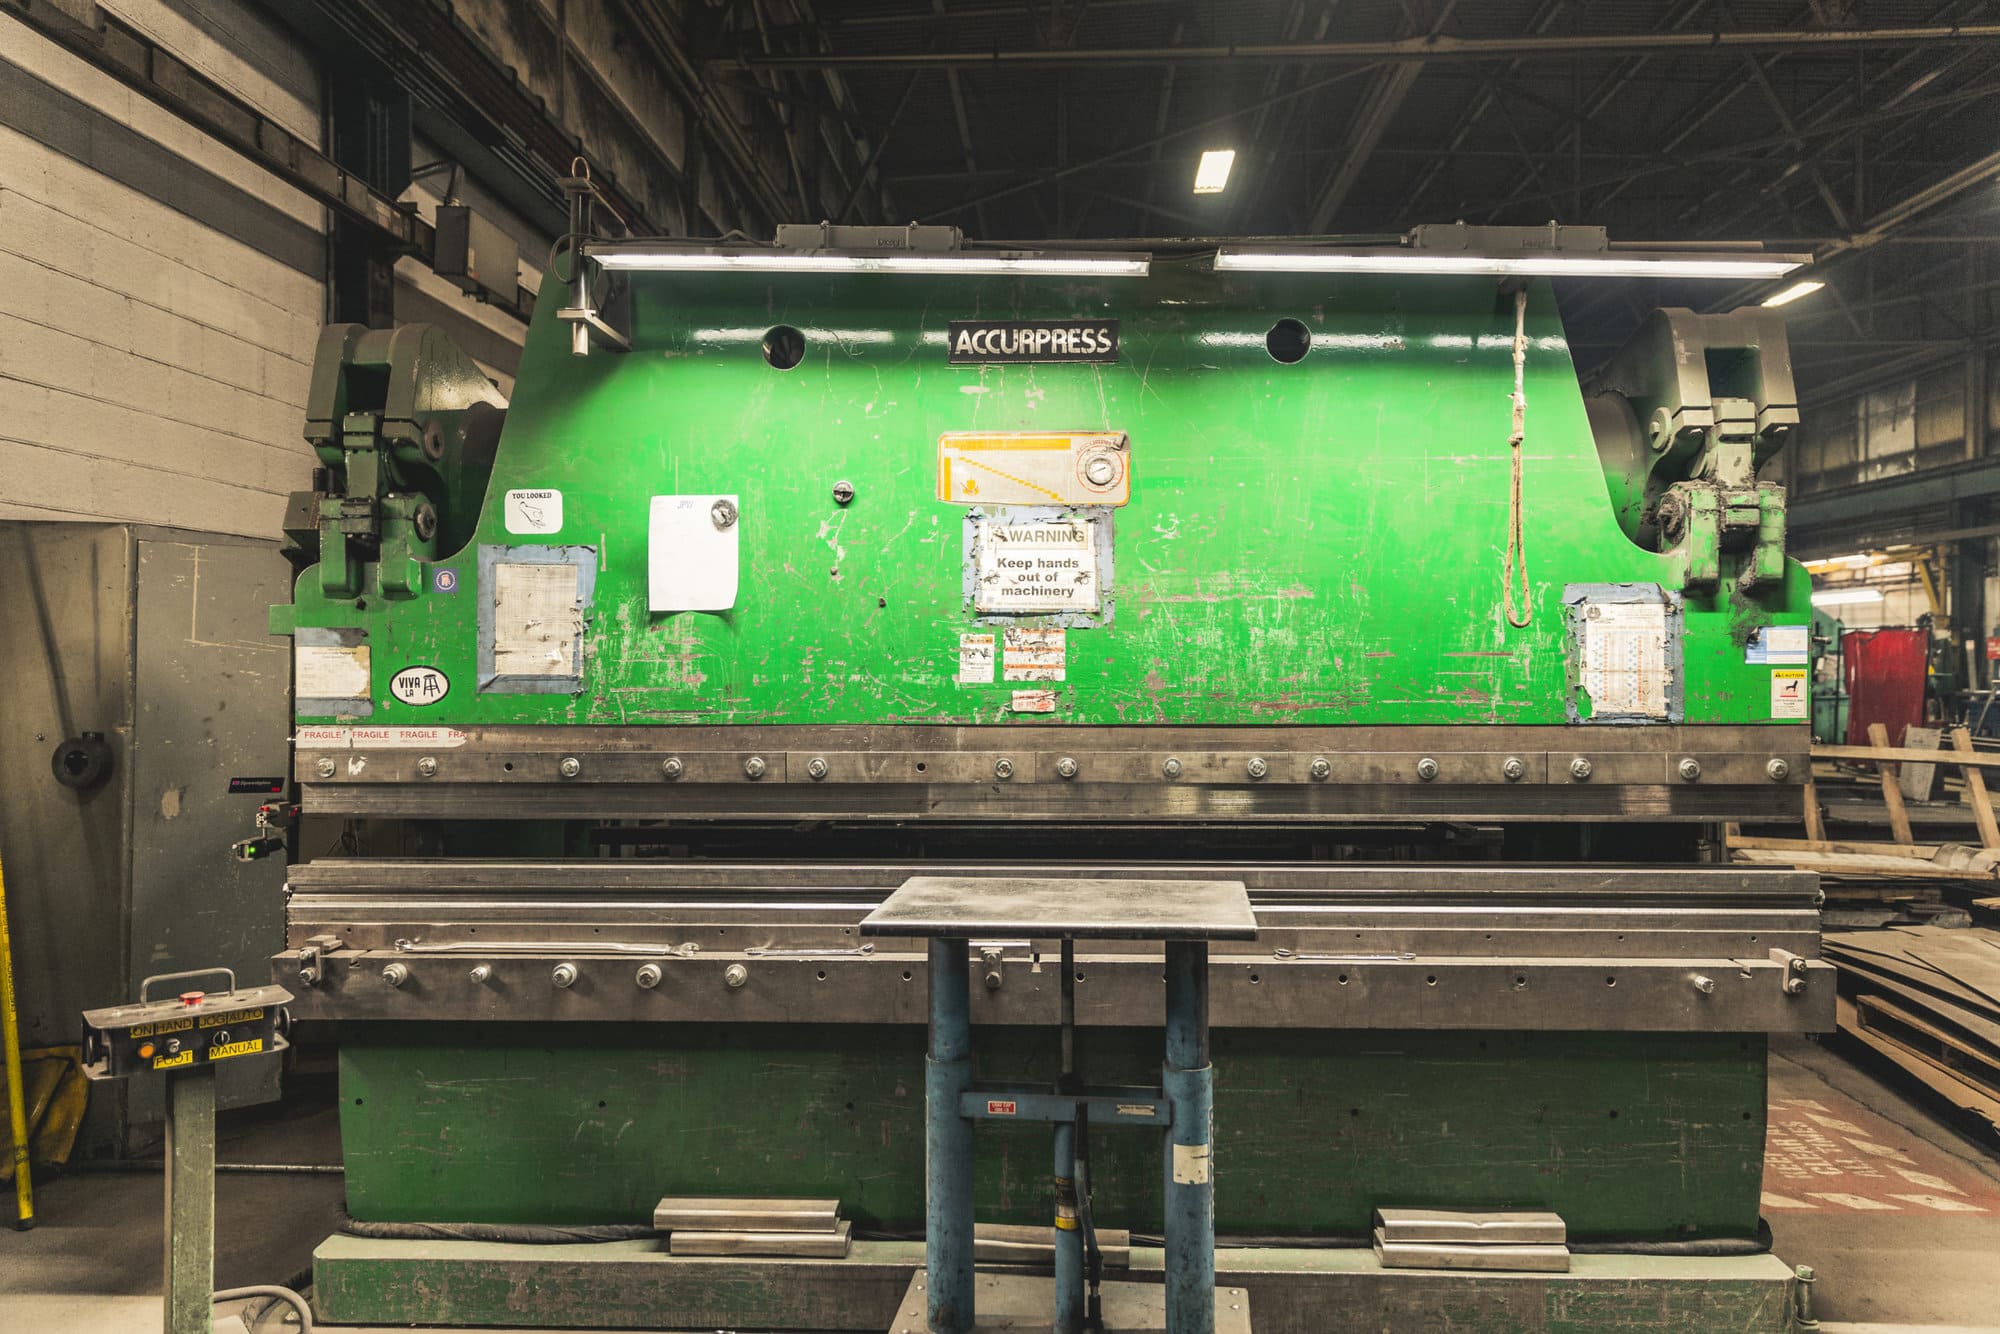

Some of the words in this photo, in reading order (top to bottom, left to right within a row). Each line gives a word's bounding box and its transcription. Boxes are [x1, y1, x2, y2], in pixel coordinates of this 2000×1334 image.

[955, 329, 1112, 354] ACCURPRESS
[1009, 530, 1085, 542] WARNING
[997, 558, 1033, 570] Keep
[1038, 558, 1079, 568] hands
[1018, 573, 1041, 582] out
[1045, 572, 1059, 582] of
[1001, 586, 1075, 598] machinery
[399, 677, 420, 688] VIVA
[406, 689, 414, 697] LA
[304, 731, 342, 739] FRAGILE
[352, 731, 390, 739] FRAGILE
[200, 1015, 226, 1026] JOG
[227, 1009, 261, 1022] AUTO
[132, 1026, 152, 1036] ON
[155, 1018, 192, 1032] HAND
[210, 1040, 260, 1057] MANUAL
[155, 1052, 191, 1066] FOOT
